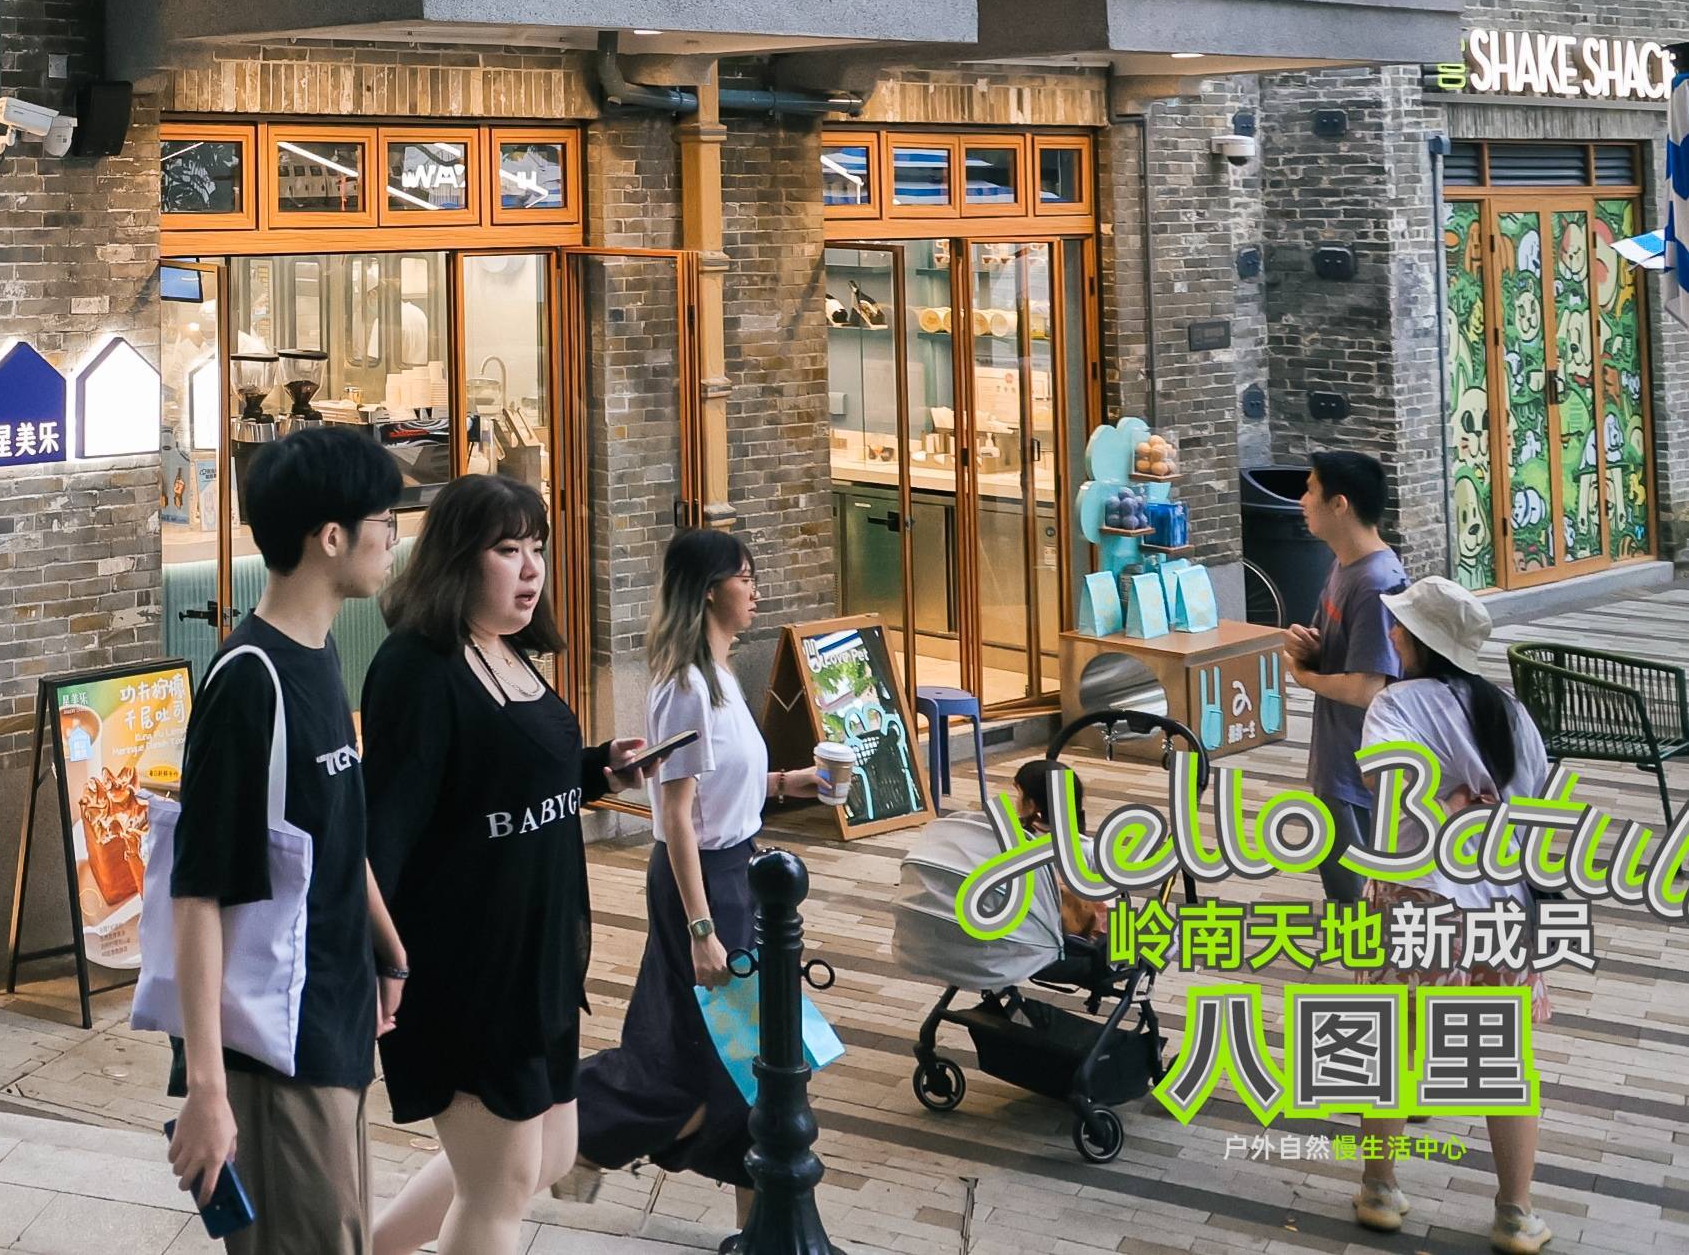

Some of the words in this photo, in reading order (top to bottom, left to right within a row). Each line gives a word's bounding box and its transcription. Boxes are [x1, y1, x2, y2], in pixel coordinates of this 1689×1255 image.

[1468, 27, 1582, 95] SHAKE
[124, 700, 186, 731] 千层吐司
